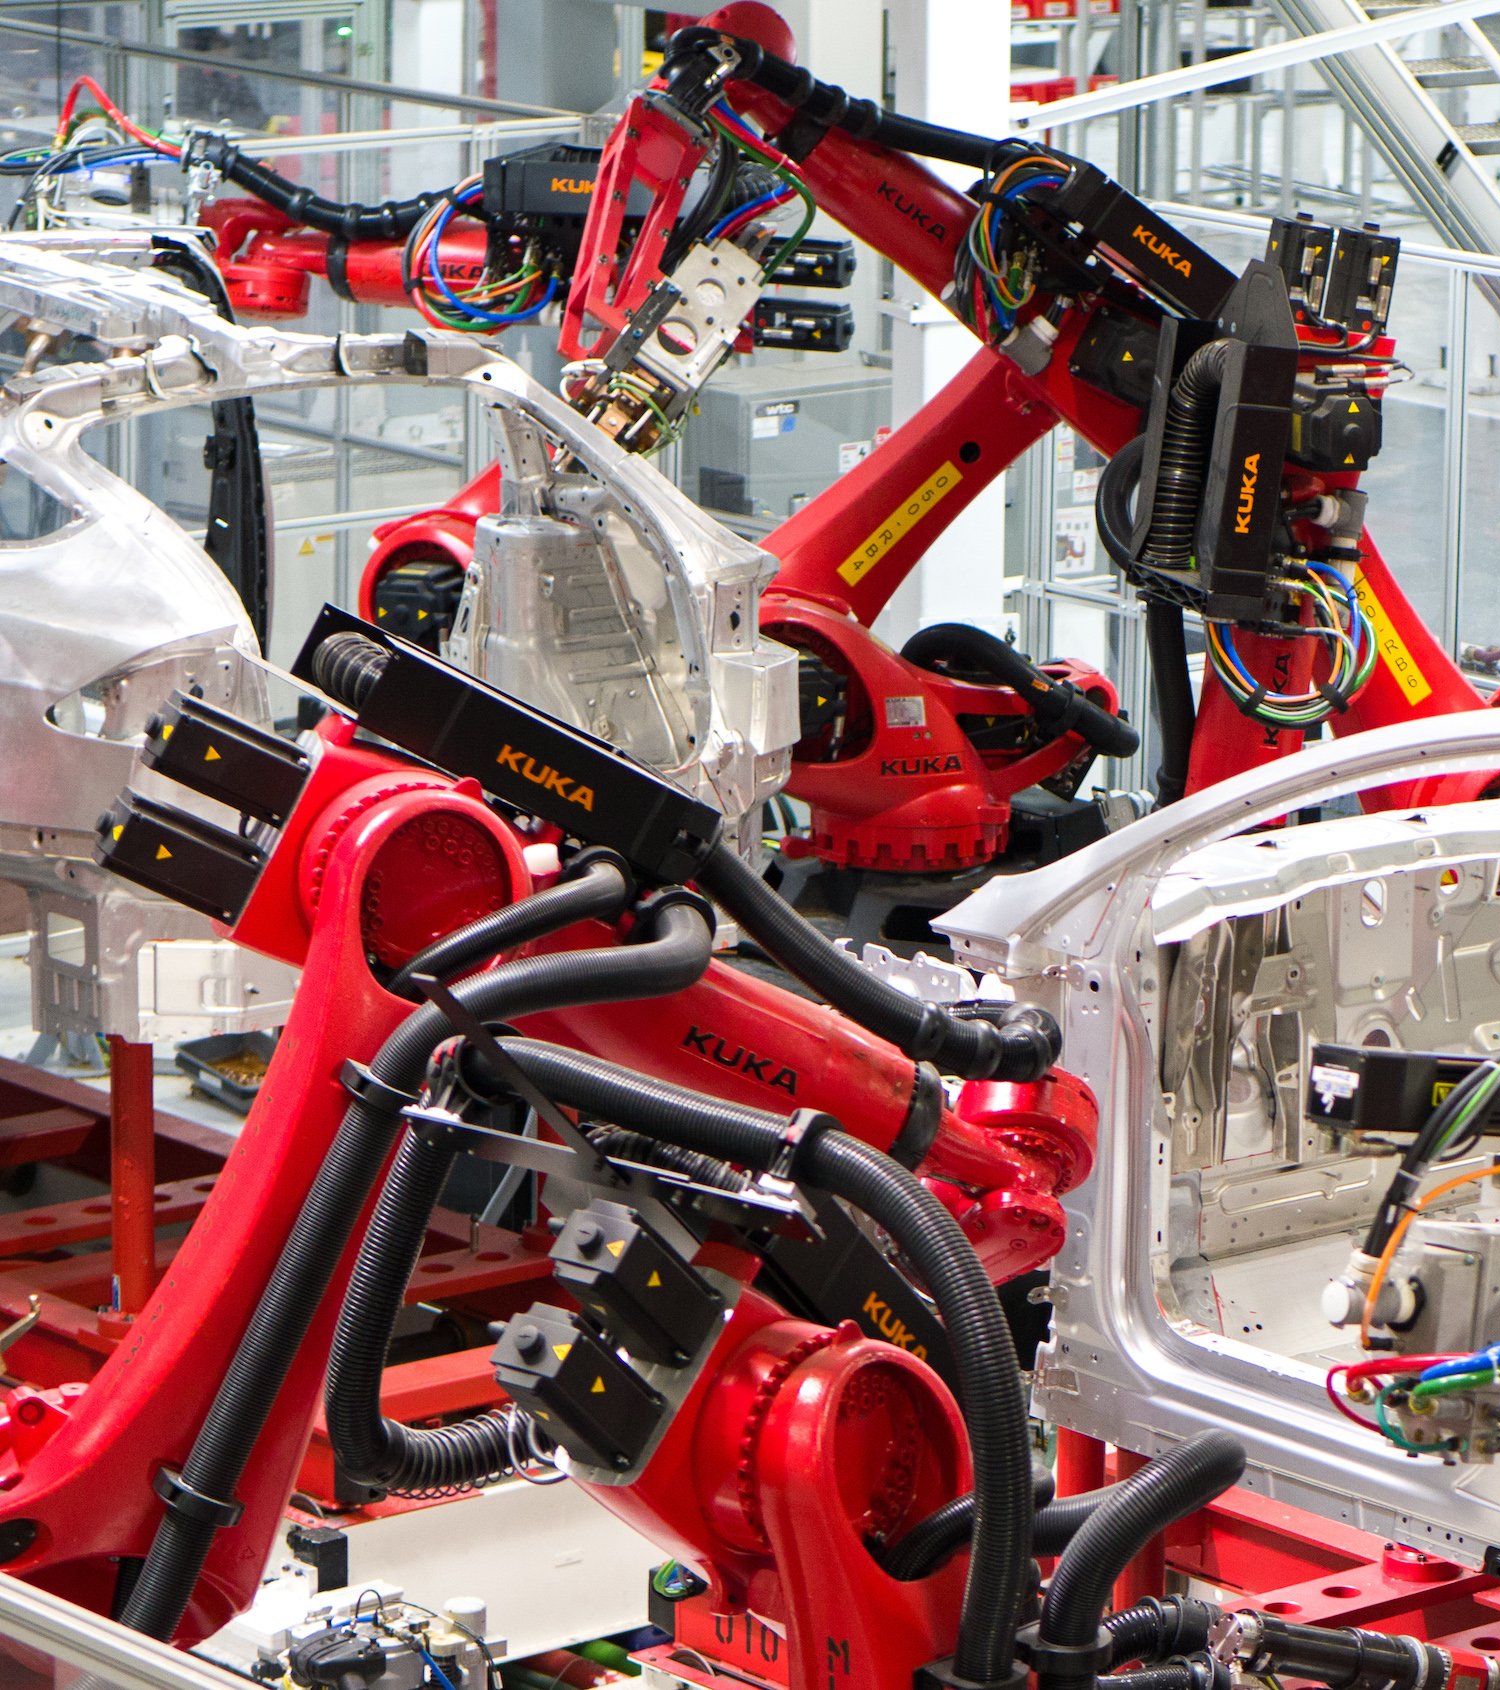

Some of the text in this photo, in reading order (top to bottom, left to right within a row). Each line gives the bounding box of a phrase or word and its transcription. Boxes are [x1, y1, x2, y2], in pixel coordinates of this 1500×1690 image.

[551, 177, 597, 194] KUK
[876, 181, 946, 242] KUKA
[1132, 225, 1193, 279] KUKA
[765, 401, 796, 416] wtc
[1235, 453, 1261, 534] KUKA
[1263, 654, 1292, 745] KKA
[495, 743, 594, 812] KUKA
[880, 755, 962, 776] KUKA
[682, 1024, 798, 1096] KUKA
[862, 1290, 928, 1361] KUKA
